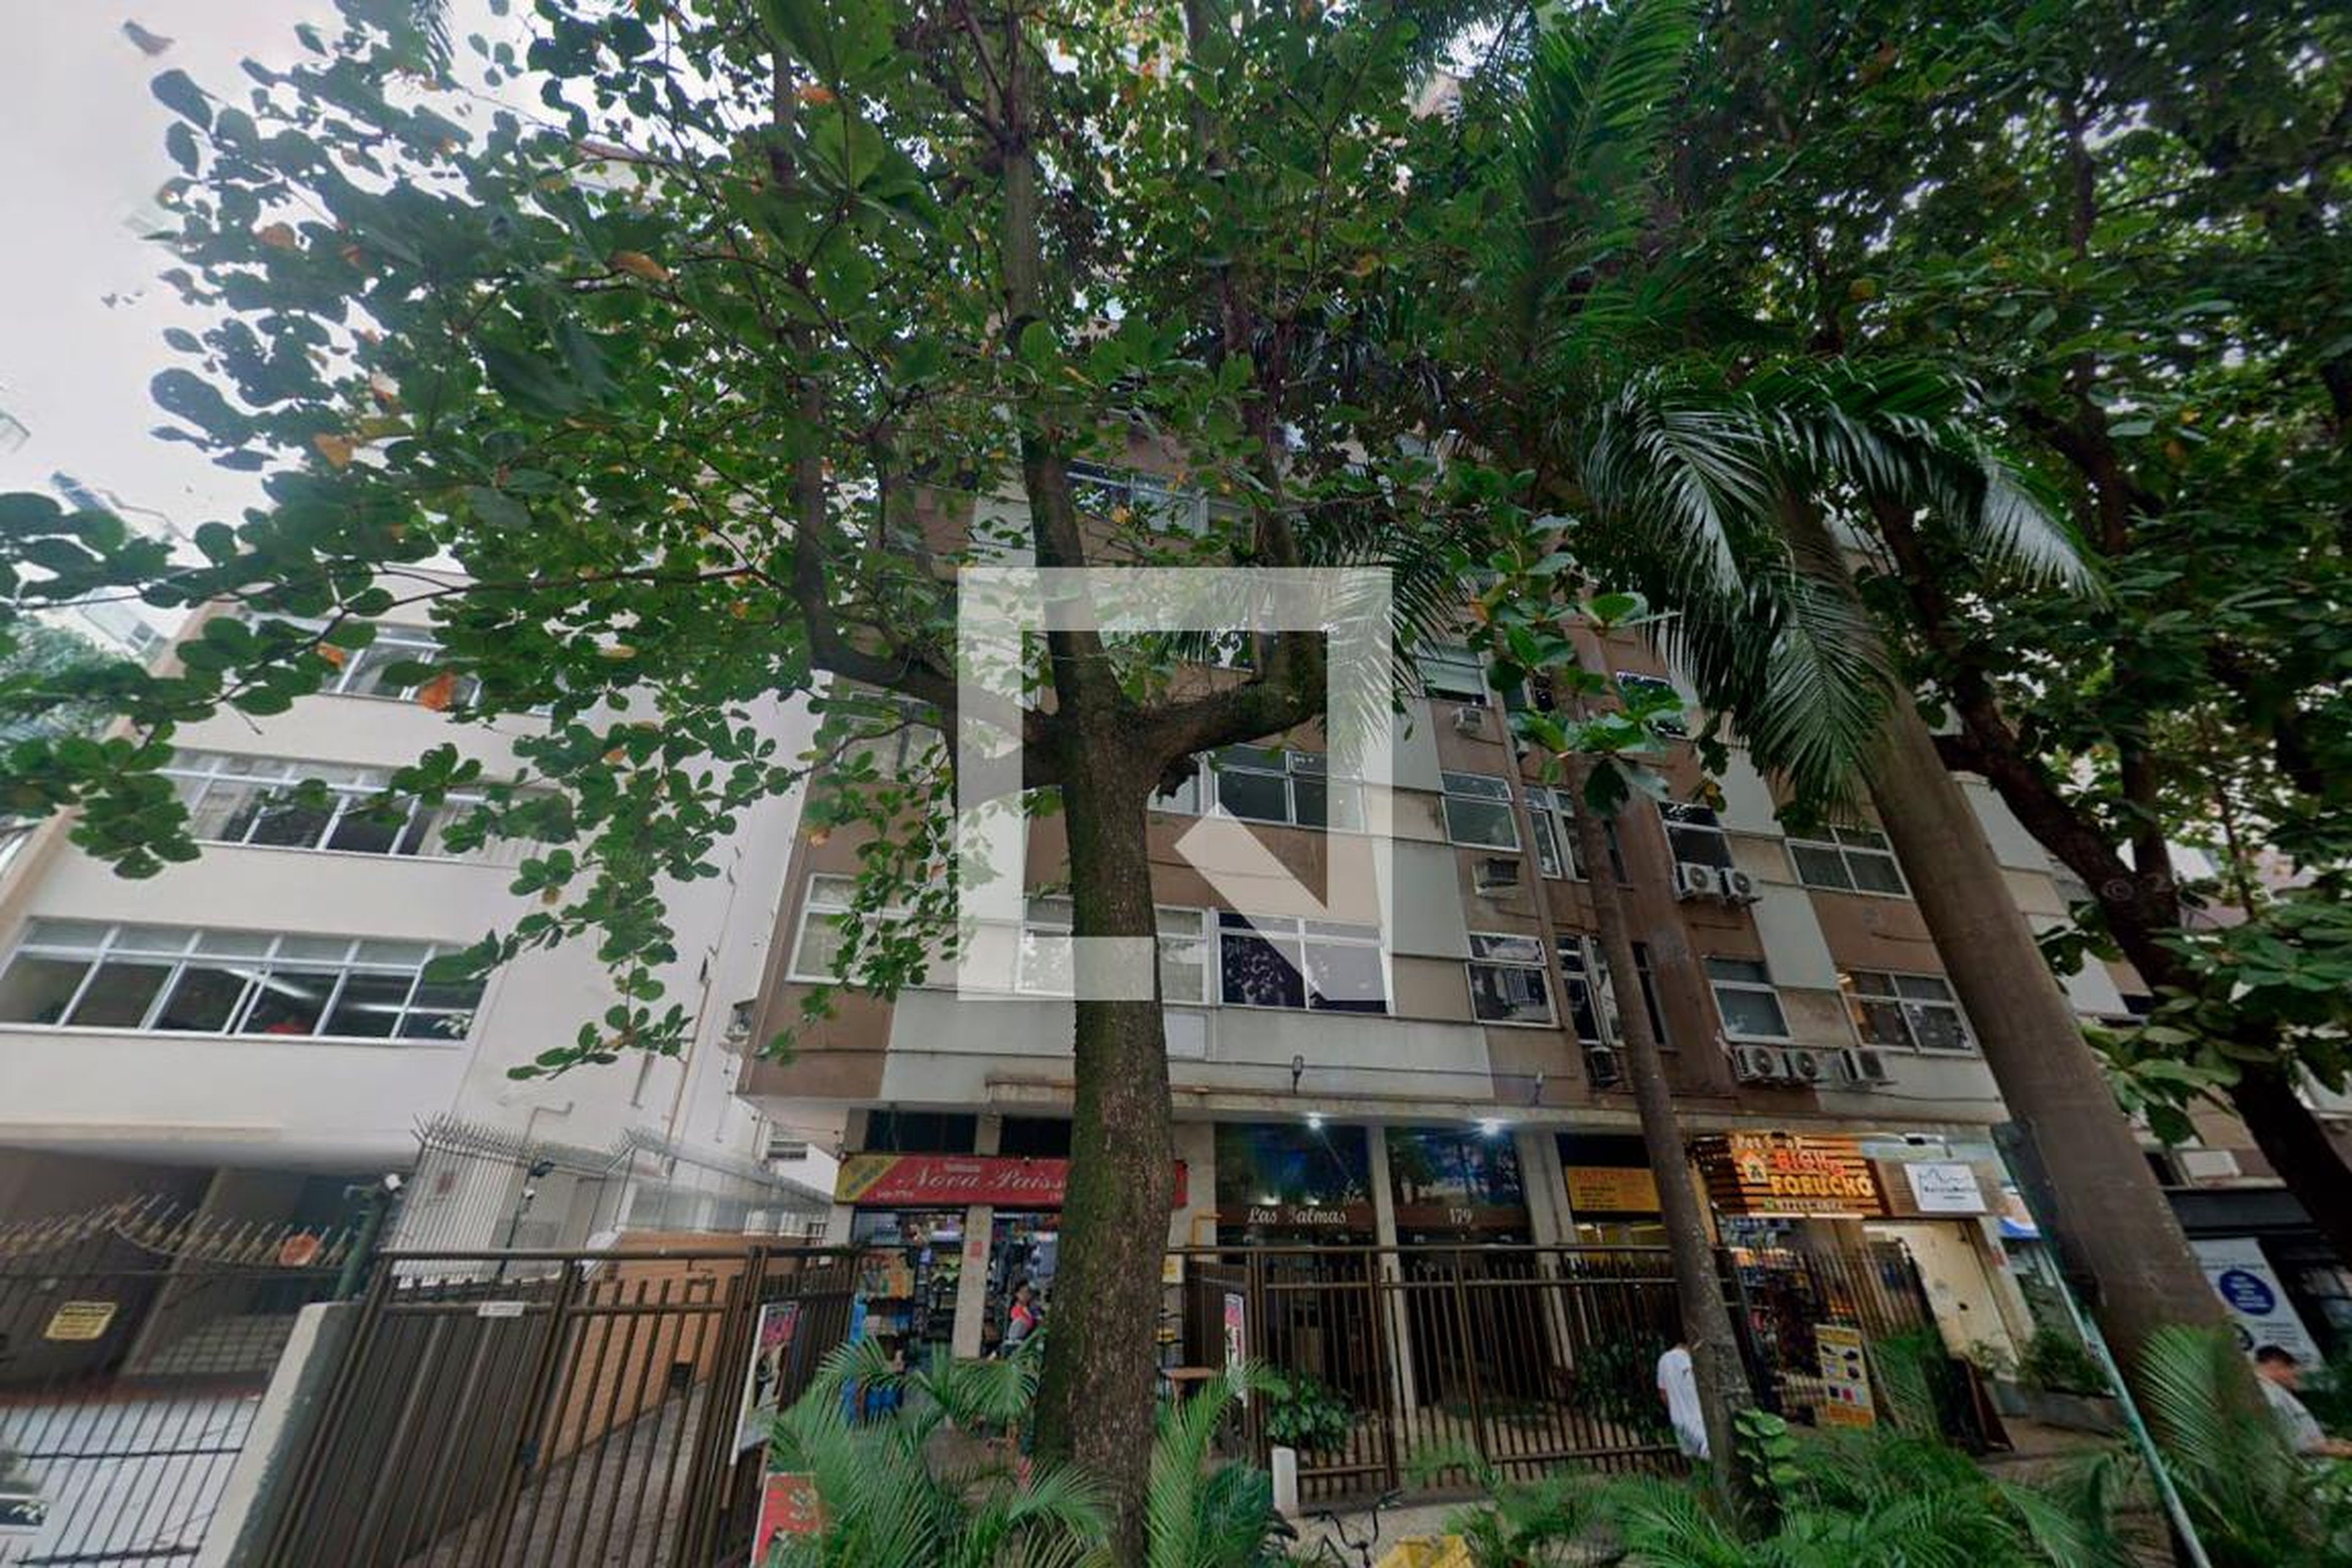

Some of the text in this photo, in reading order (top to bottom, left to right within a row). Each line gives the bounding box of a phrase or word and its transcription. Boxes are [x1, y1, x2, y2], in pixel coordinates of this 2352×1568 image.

[897, 1165, 981, 1188] Nova
[987, 1169, 1067, 1189] Paiss
[1248, 1207, 1277, 1224] Las
[1449, 1208, 1472, 1225] 179
